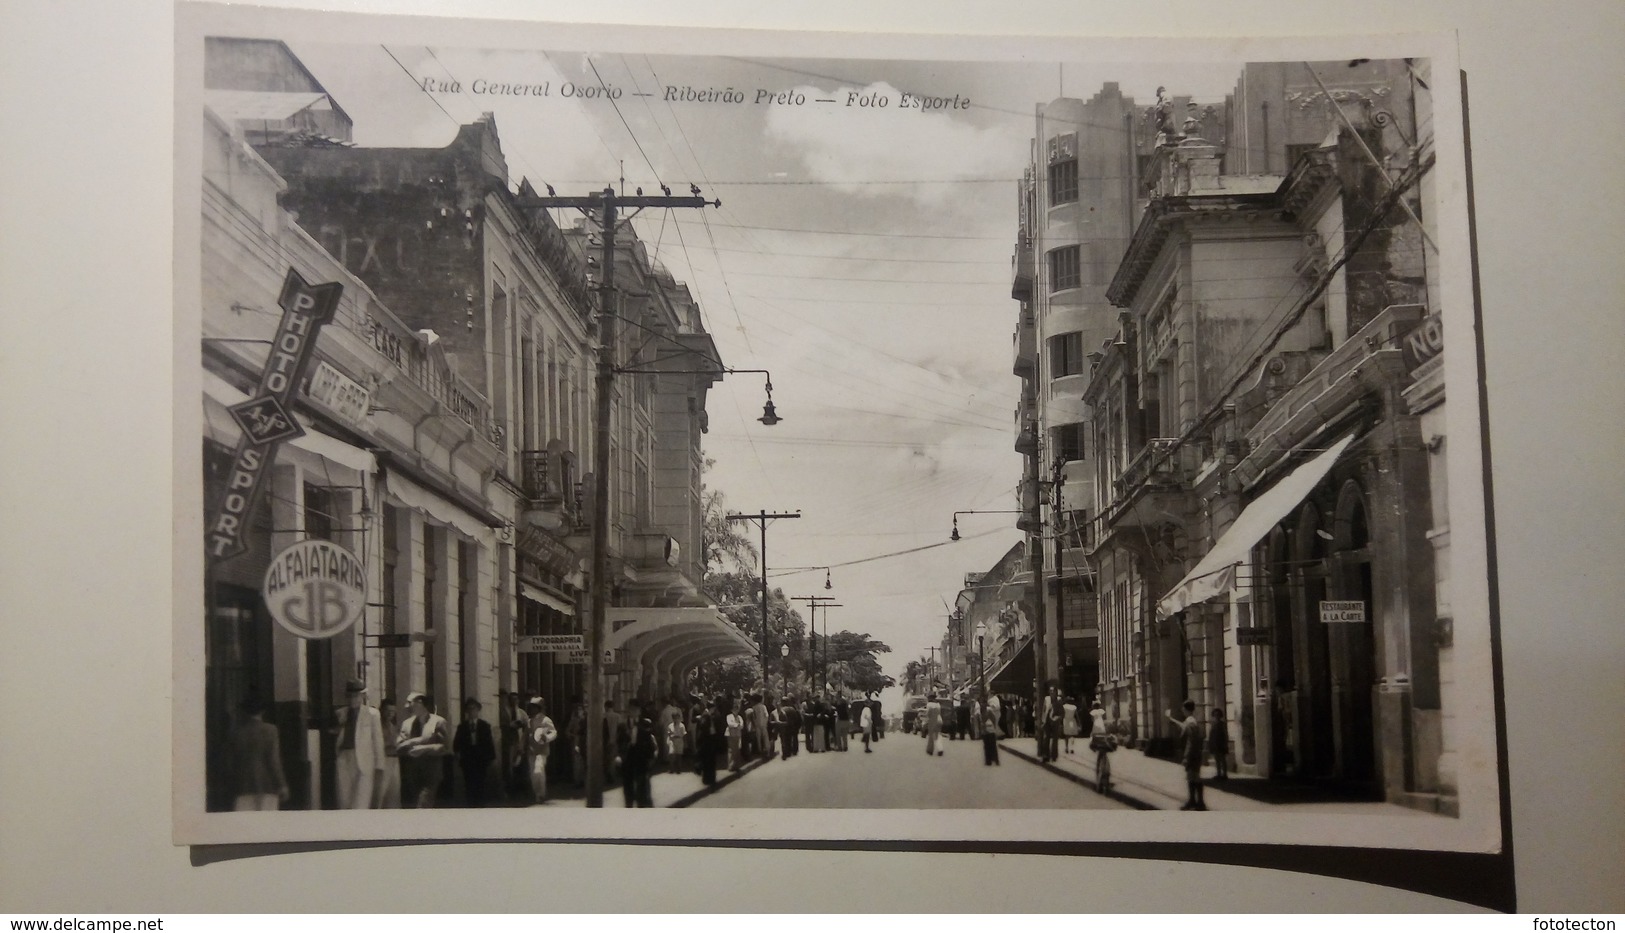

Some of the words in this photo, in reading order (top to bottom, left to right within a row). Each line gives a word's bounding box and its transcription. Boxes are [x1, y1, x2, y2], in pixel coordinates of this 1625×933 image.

[267, 292, 315, 393] PHOTO
[374, 322, 402, 369] CASA
[211, 449, 262, 557] SPORT
[268, 545, 365, 595] ALFAIATARIA
[282, 581, 348, 631] JB
[1322, 602, 1363, 611] RESTAURANTE
[1330, 612, 1339, 620] LA
